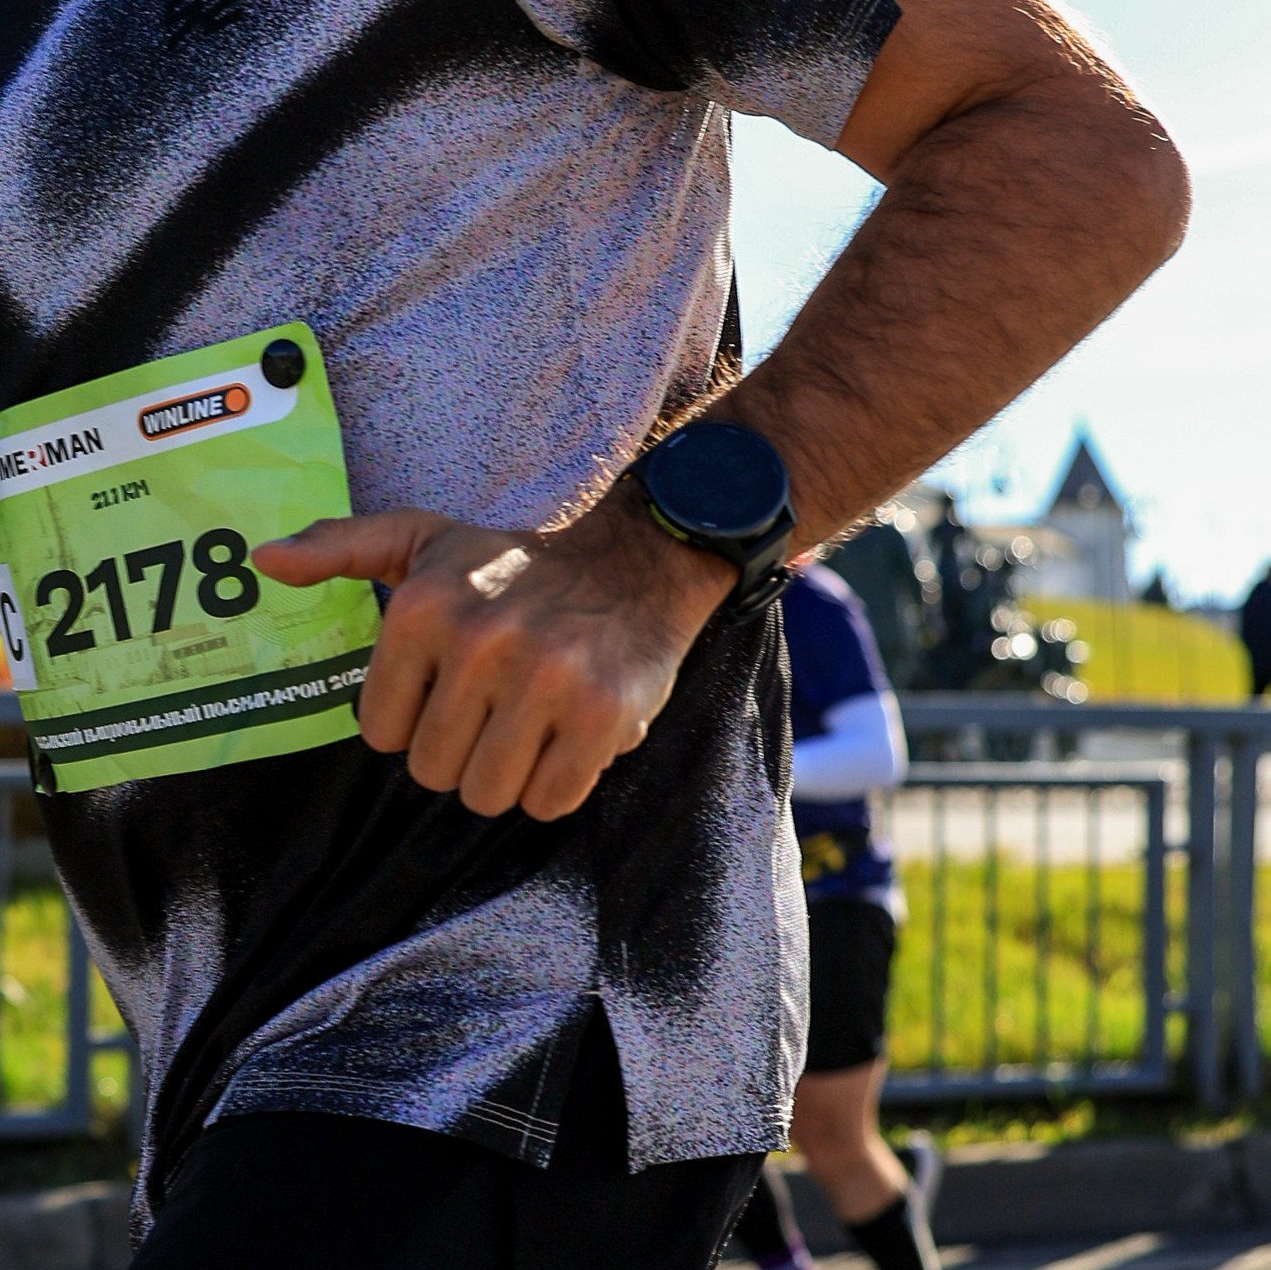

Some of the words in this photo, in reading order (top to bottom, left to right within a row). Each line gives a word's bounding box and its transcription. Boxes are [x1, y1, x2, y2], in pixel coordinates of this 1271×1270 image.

[142, 395, 223, 434] WINLINE
[35, 527, 260, 658] 2178
[201, 679, 329, 720] ПОЛУМАРАФОН
